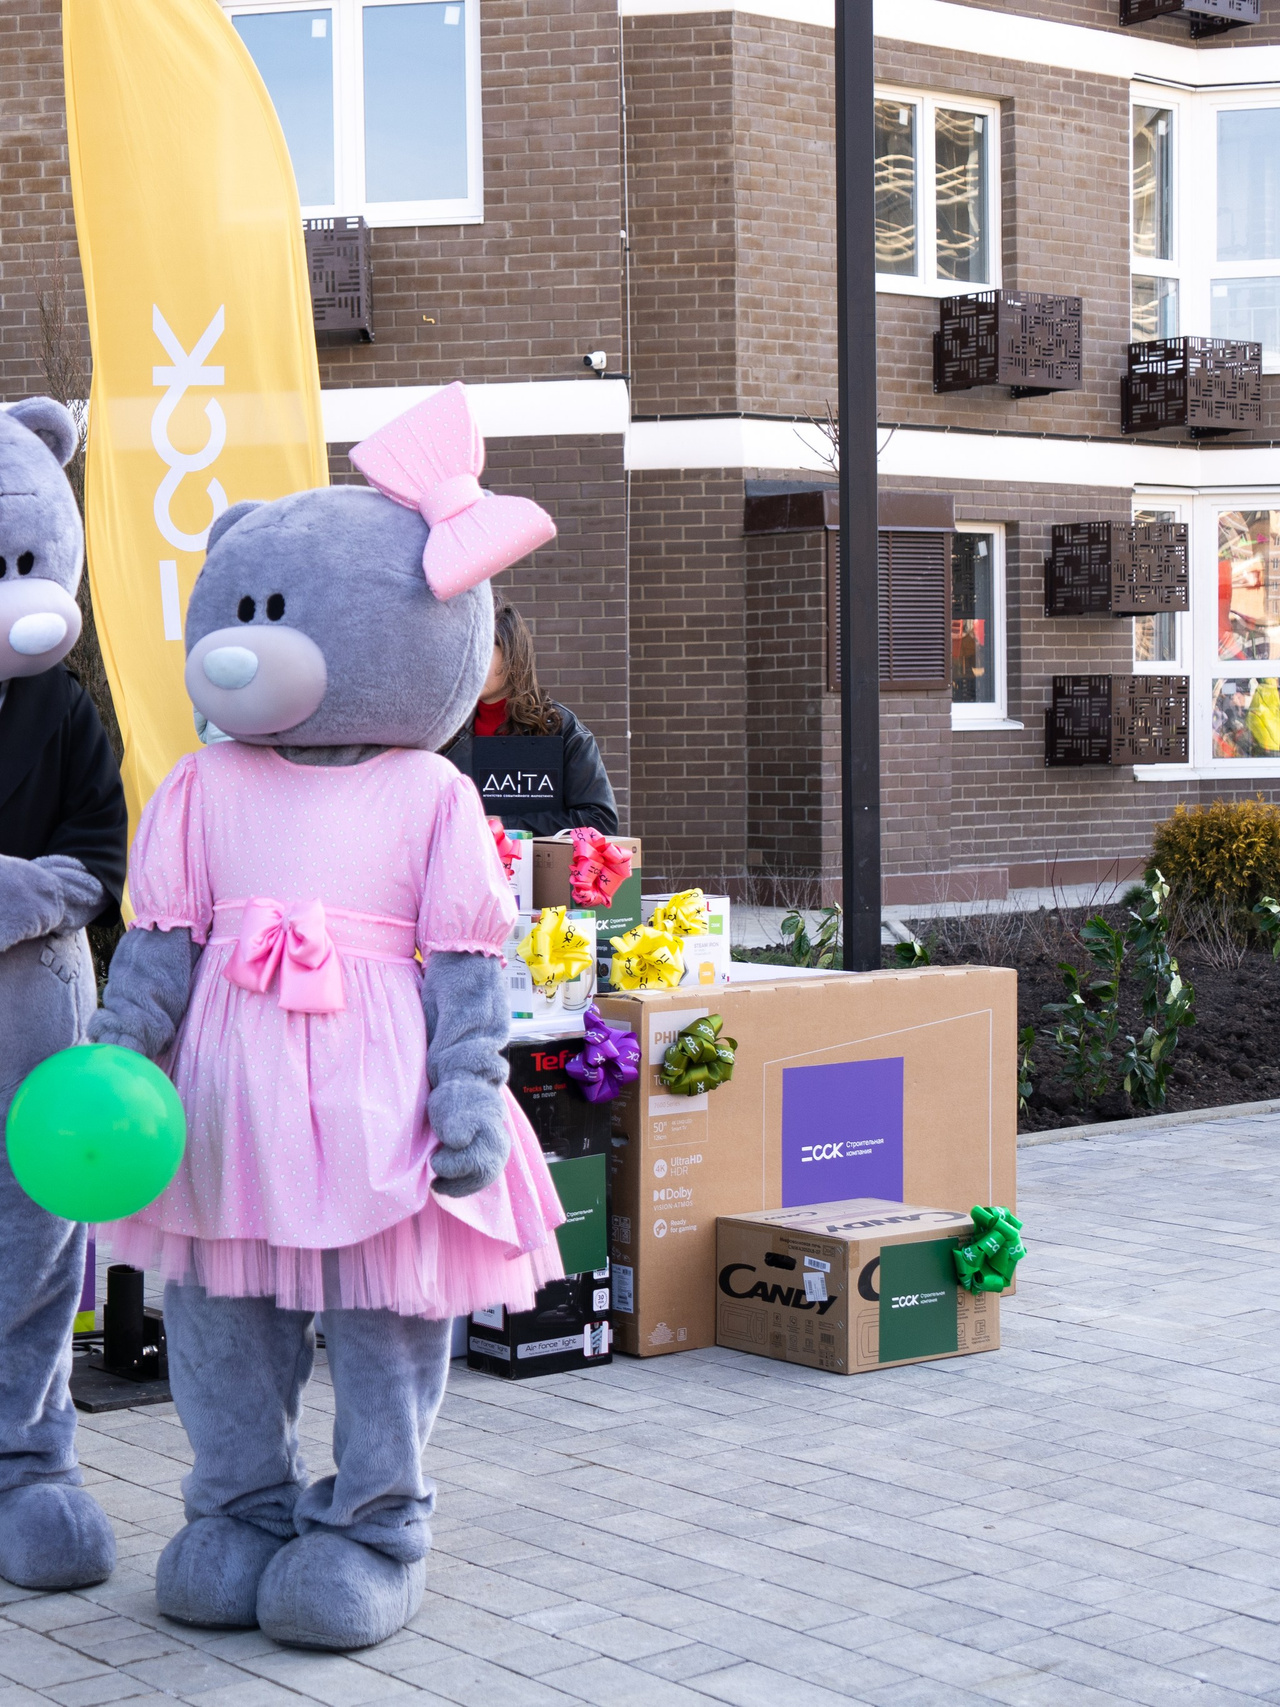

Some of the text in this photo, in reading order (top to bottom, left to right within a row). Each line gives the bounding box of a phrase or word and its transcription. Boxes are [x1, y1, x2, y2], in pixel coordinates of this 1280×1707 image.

[845, 1138, 885, 1149] Строительная
[845, 1148, 873, 1157] компания
[670, 1154, 703, 1167] UltraHD
[670, 1166, 689, 1177] HDR
[666, 1187, 693, 1201] Dolby
[670, 1219, 687, 1227] Ready
[670, 1225, 698, 1234] for gaming
[719, 1263, 838, 1315] CANDY
[920, 1291, 946, 1299] Строительная
[562, 1337, 577, 1346] light
